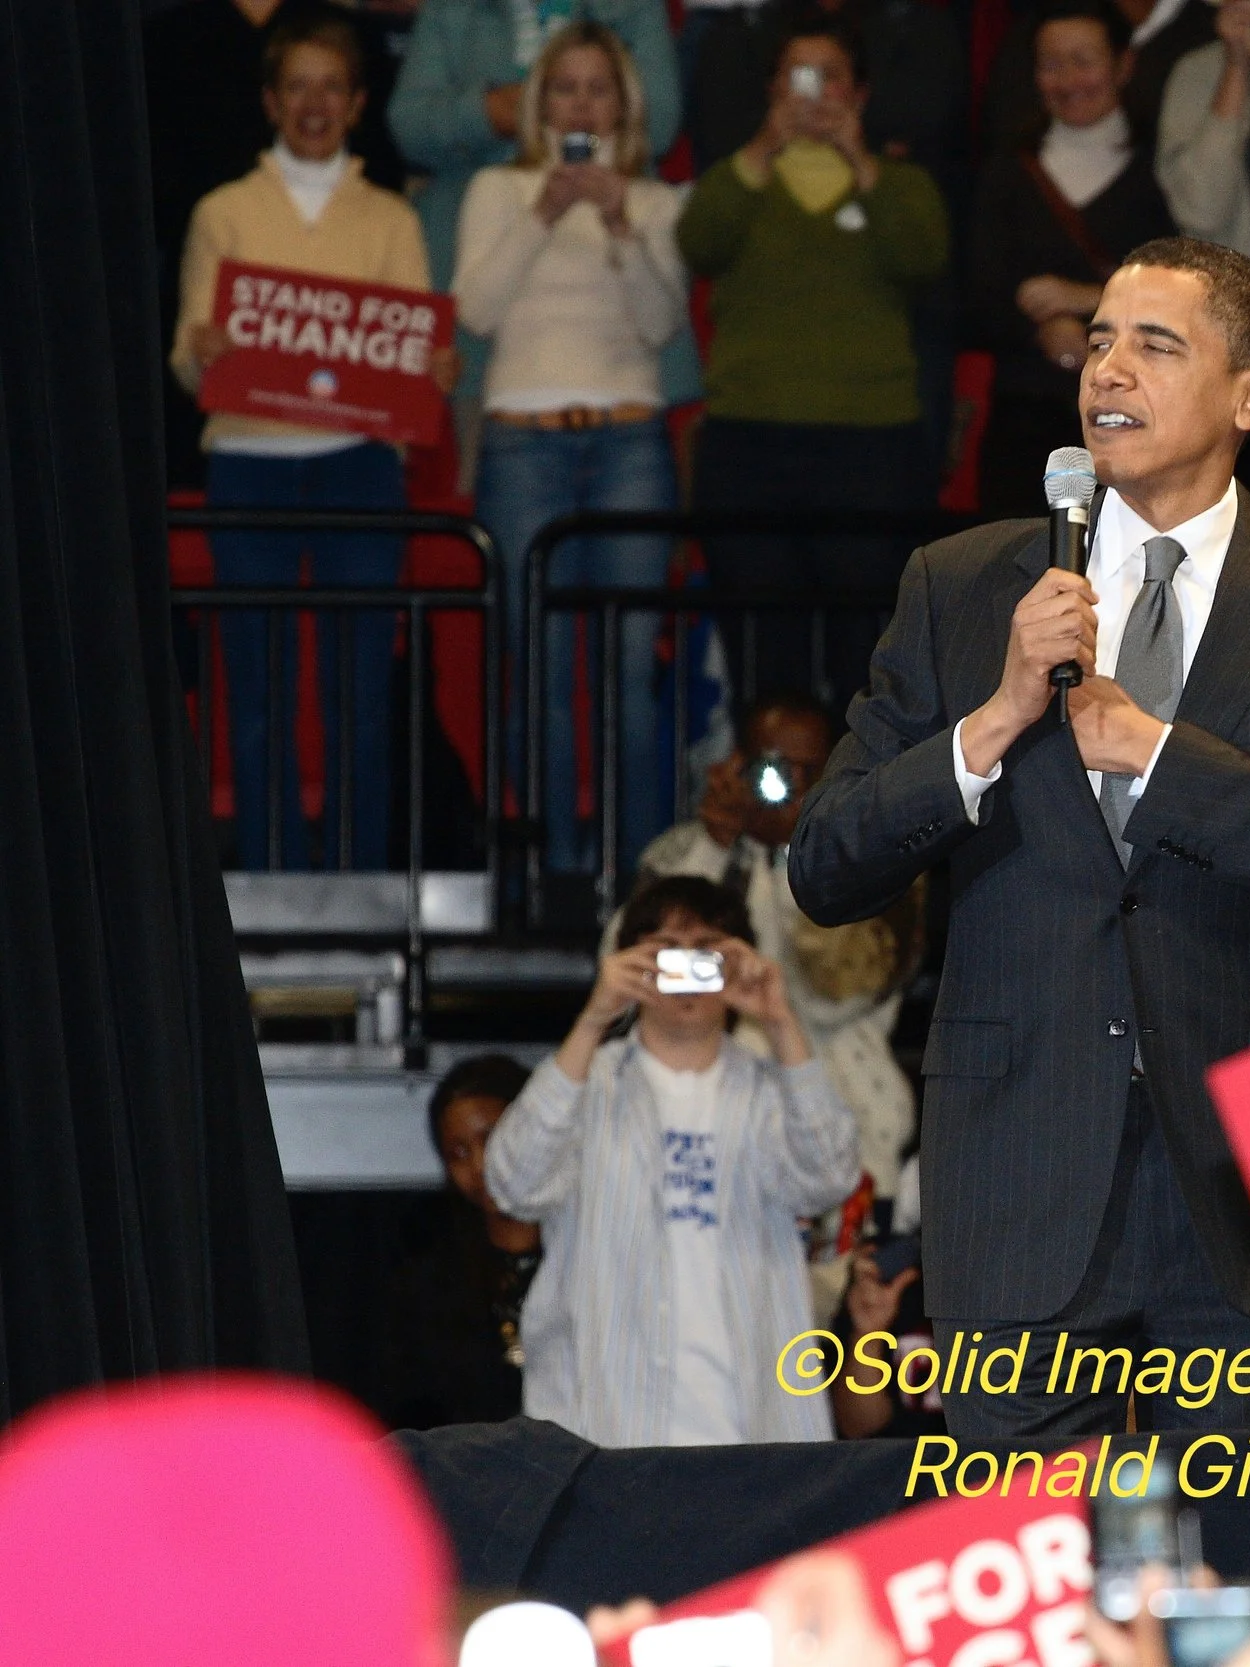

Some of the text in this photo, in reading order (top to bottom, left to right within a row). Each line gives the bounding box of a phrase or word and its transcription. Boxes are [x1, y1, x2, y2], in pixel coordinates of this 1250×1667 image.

[231, 275, 437, 334] STAND FOR
[226, 308, 431, 376] CHANGE
[885, 1512, 1096, 1655] FOR
